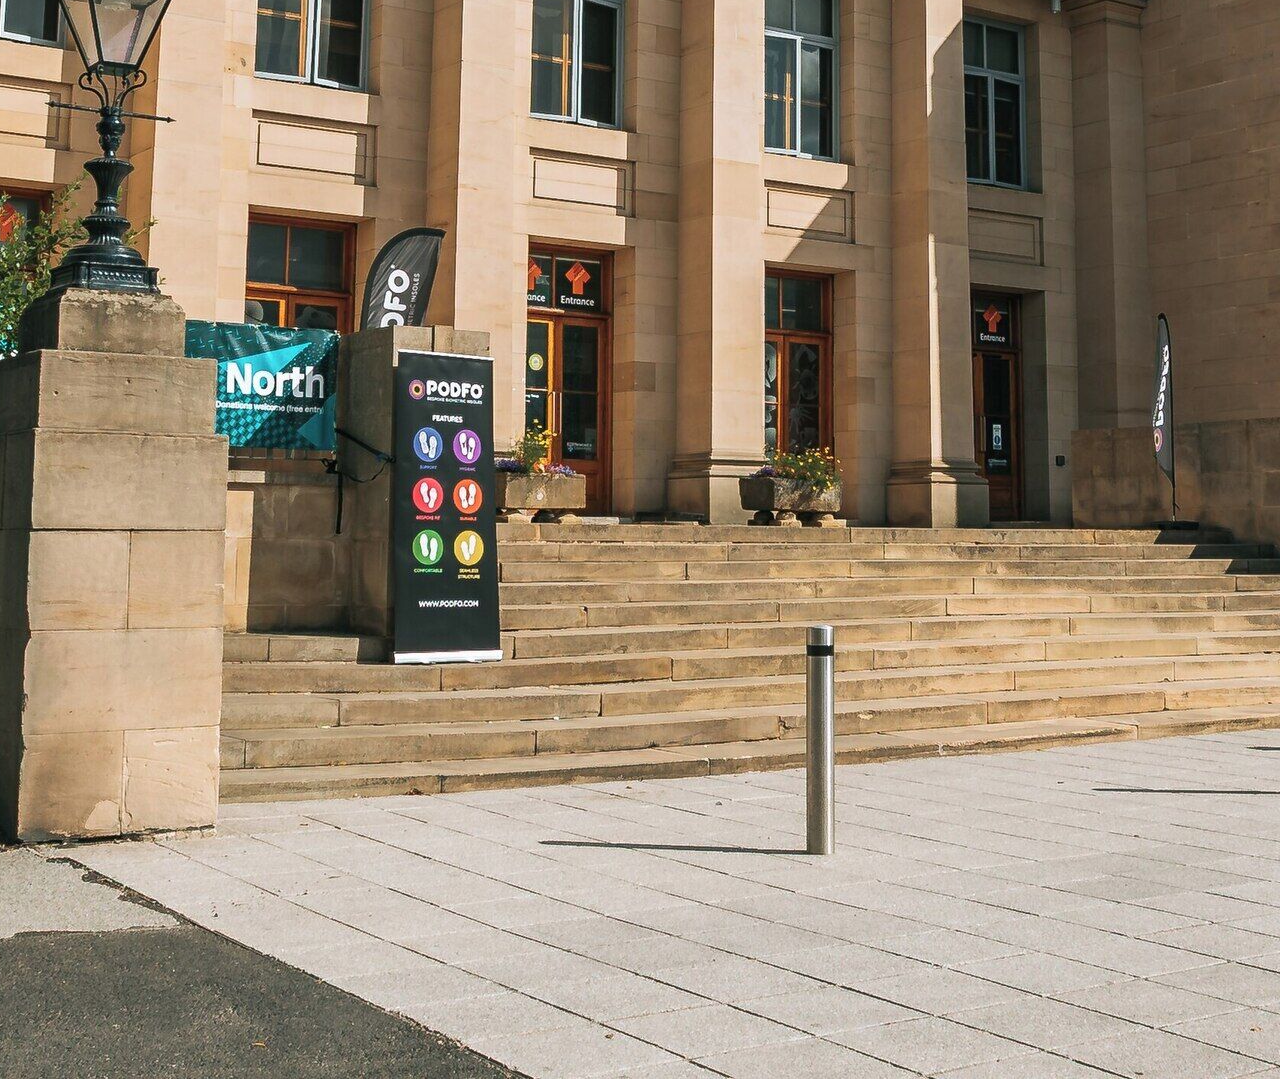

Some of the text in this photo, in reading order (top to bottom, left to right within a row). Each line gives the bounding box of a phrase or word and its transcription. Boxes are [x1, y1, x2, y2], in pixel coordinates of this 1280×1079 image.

[410, 272, 421, 303] INSOLES
[380, 269, 411, 327] DFO
[527, 293, 546, 303] ance
[560, 295, 595, 307] Entrance
[980, 332, 1006, 343] Entrance
[226, 362, 325, 399] North
[426, 379, 483, 400] PODFO
[215, 400, 253, 410] Donations
[253, 402, 286, 412] welcome
[286, 404, 304, 414] (free
[432, 414, 463, 424] FEATURES
[418, 600, 479, 608] WWW.PODFO.COM
